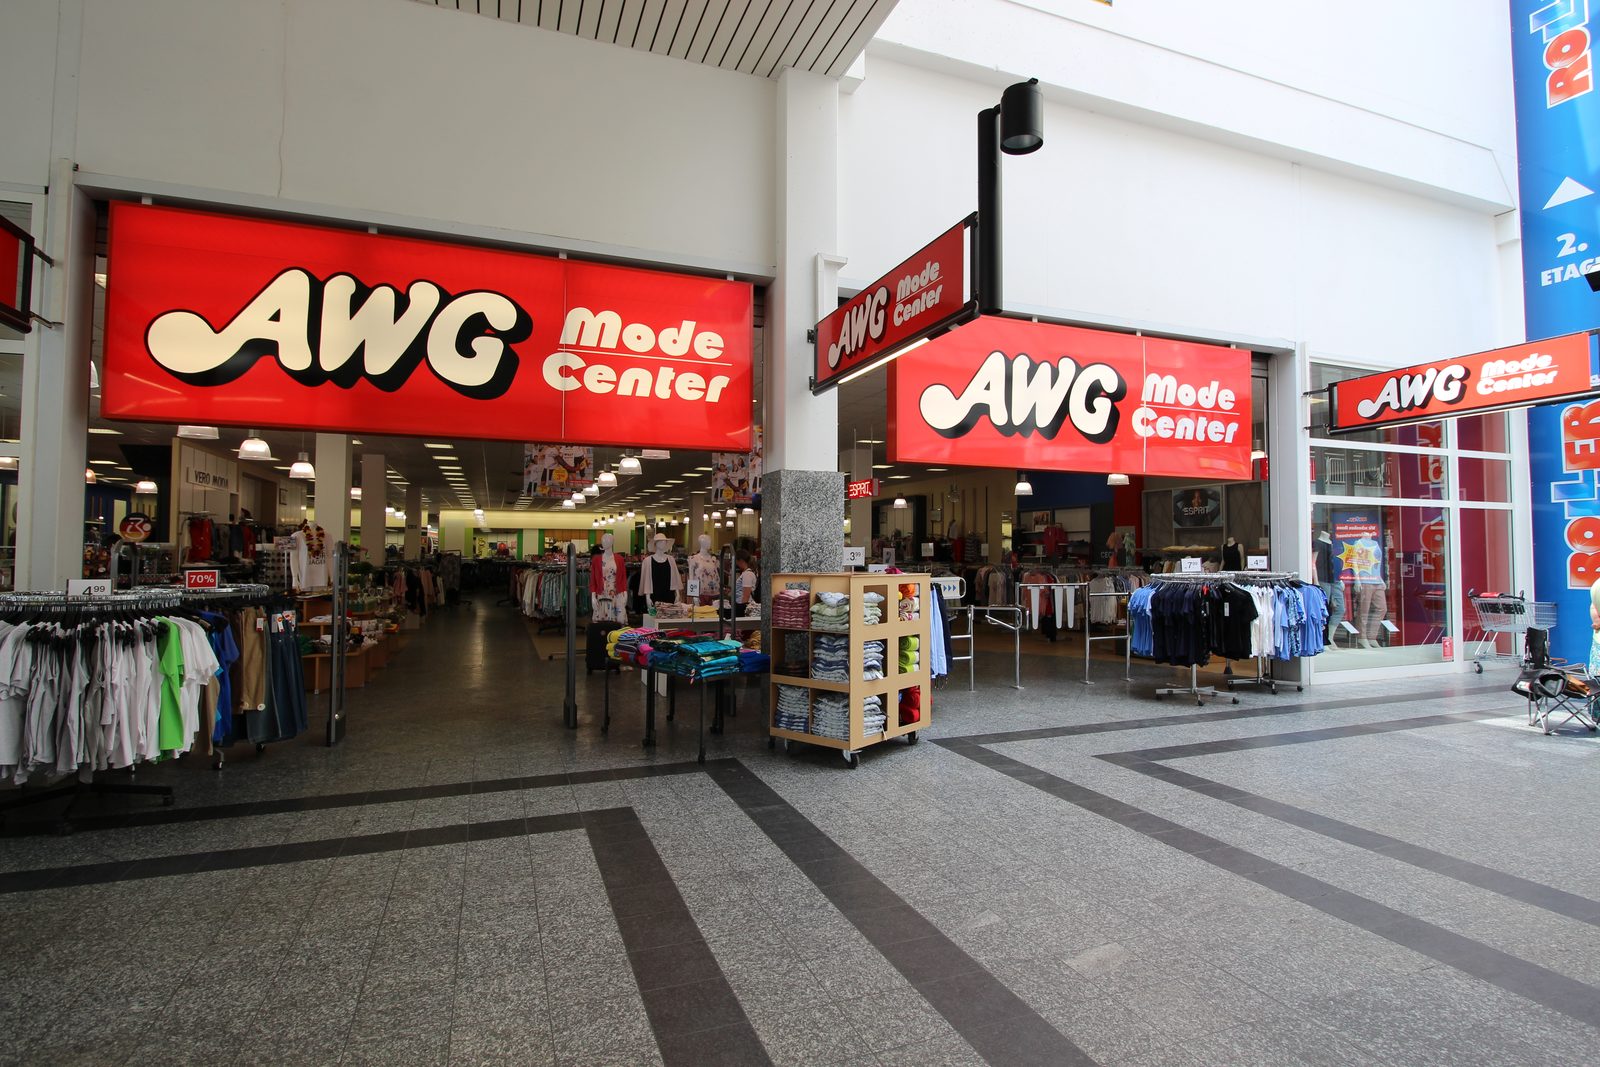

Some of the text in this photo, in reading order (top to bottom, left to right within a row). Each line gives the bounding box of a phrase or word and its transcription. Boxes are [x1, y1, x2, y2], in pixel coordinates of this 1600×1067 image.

[1556, 233, 1588, 258] 2.
[896, 261, 939, 302] Mode
[893, 285, 943, 327] Center
[144, 266, 533, 400] AWG
[559, 307, 724, 359] Mode
[828, 286, 889, 369] AWG
[542, 352, 730, 402] Center
[1476, 371, 1557, 395] Center
[1481, 353, 1552, 378] Mode
[919, 350, 1126, 443] AWG
[1141, 373, 1236, 410] Mode
[1357, 364, 1470, 419] AWG
[1132, 407, 1238, 443] Center
[195, 470, 210, 485] VERO
[849, 482, 870, 496] ESPRIT
[1183, 506, 1209, 516] ESPRIT
[190, 575, 214, 584] 70%
